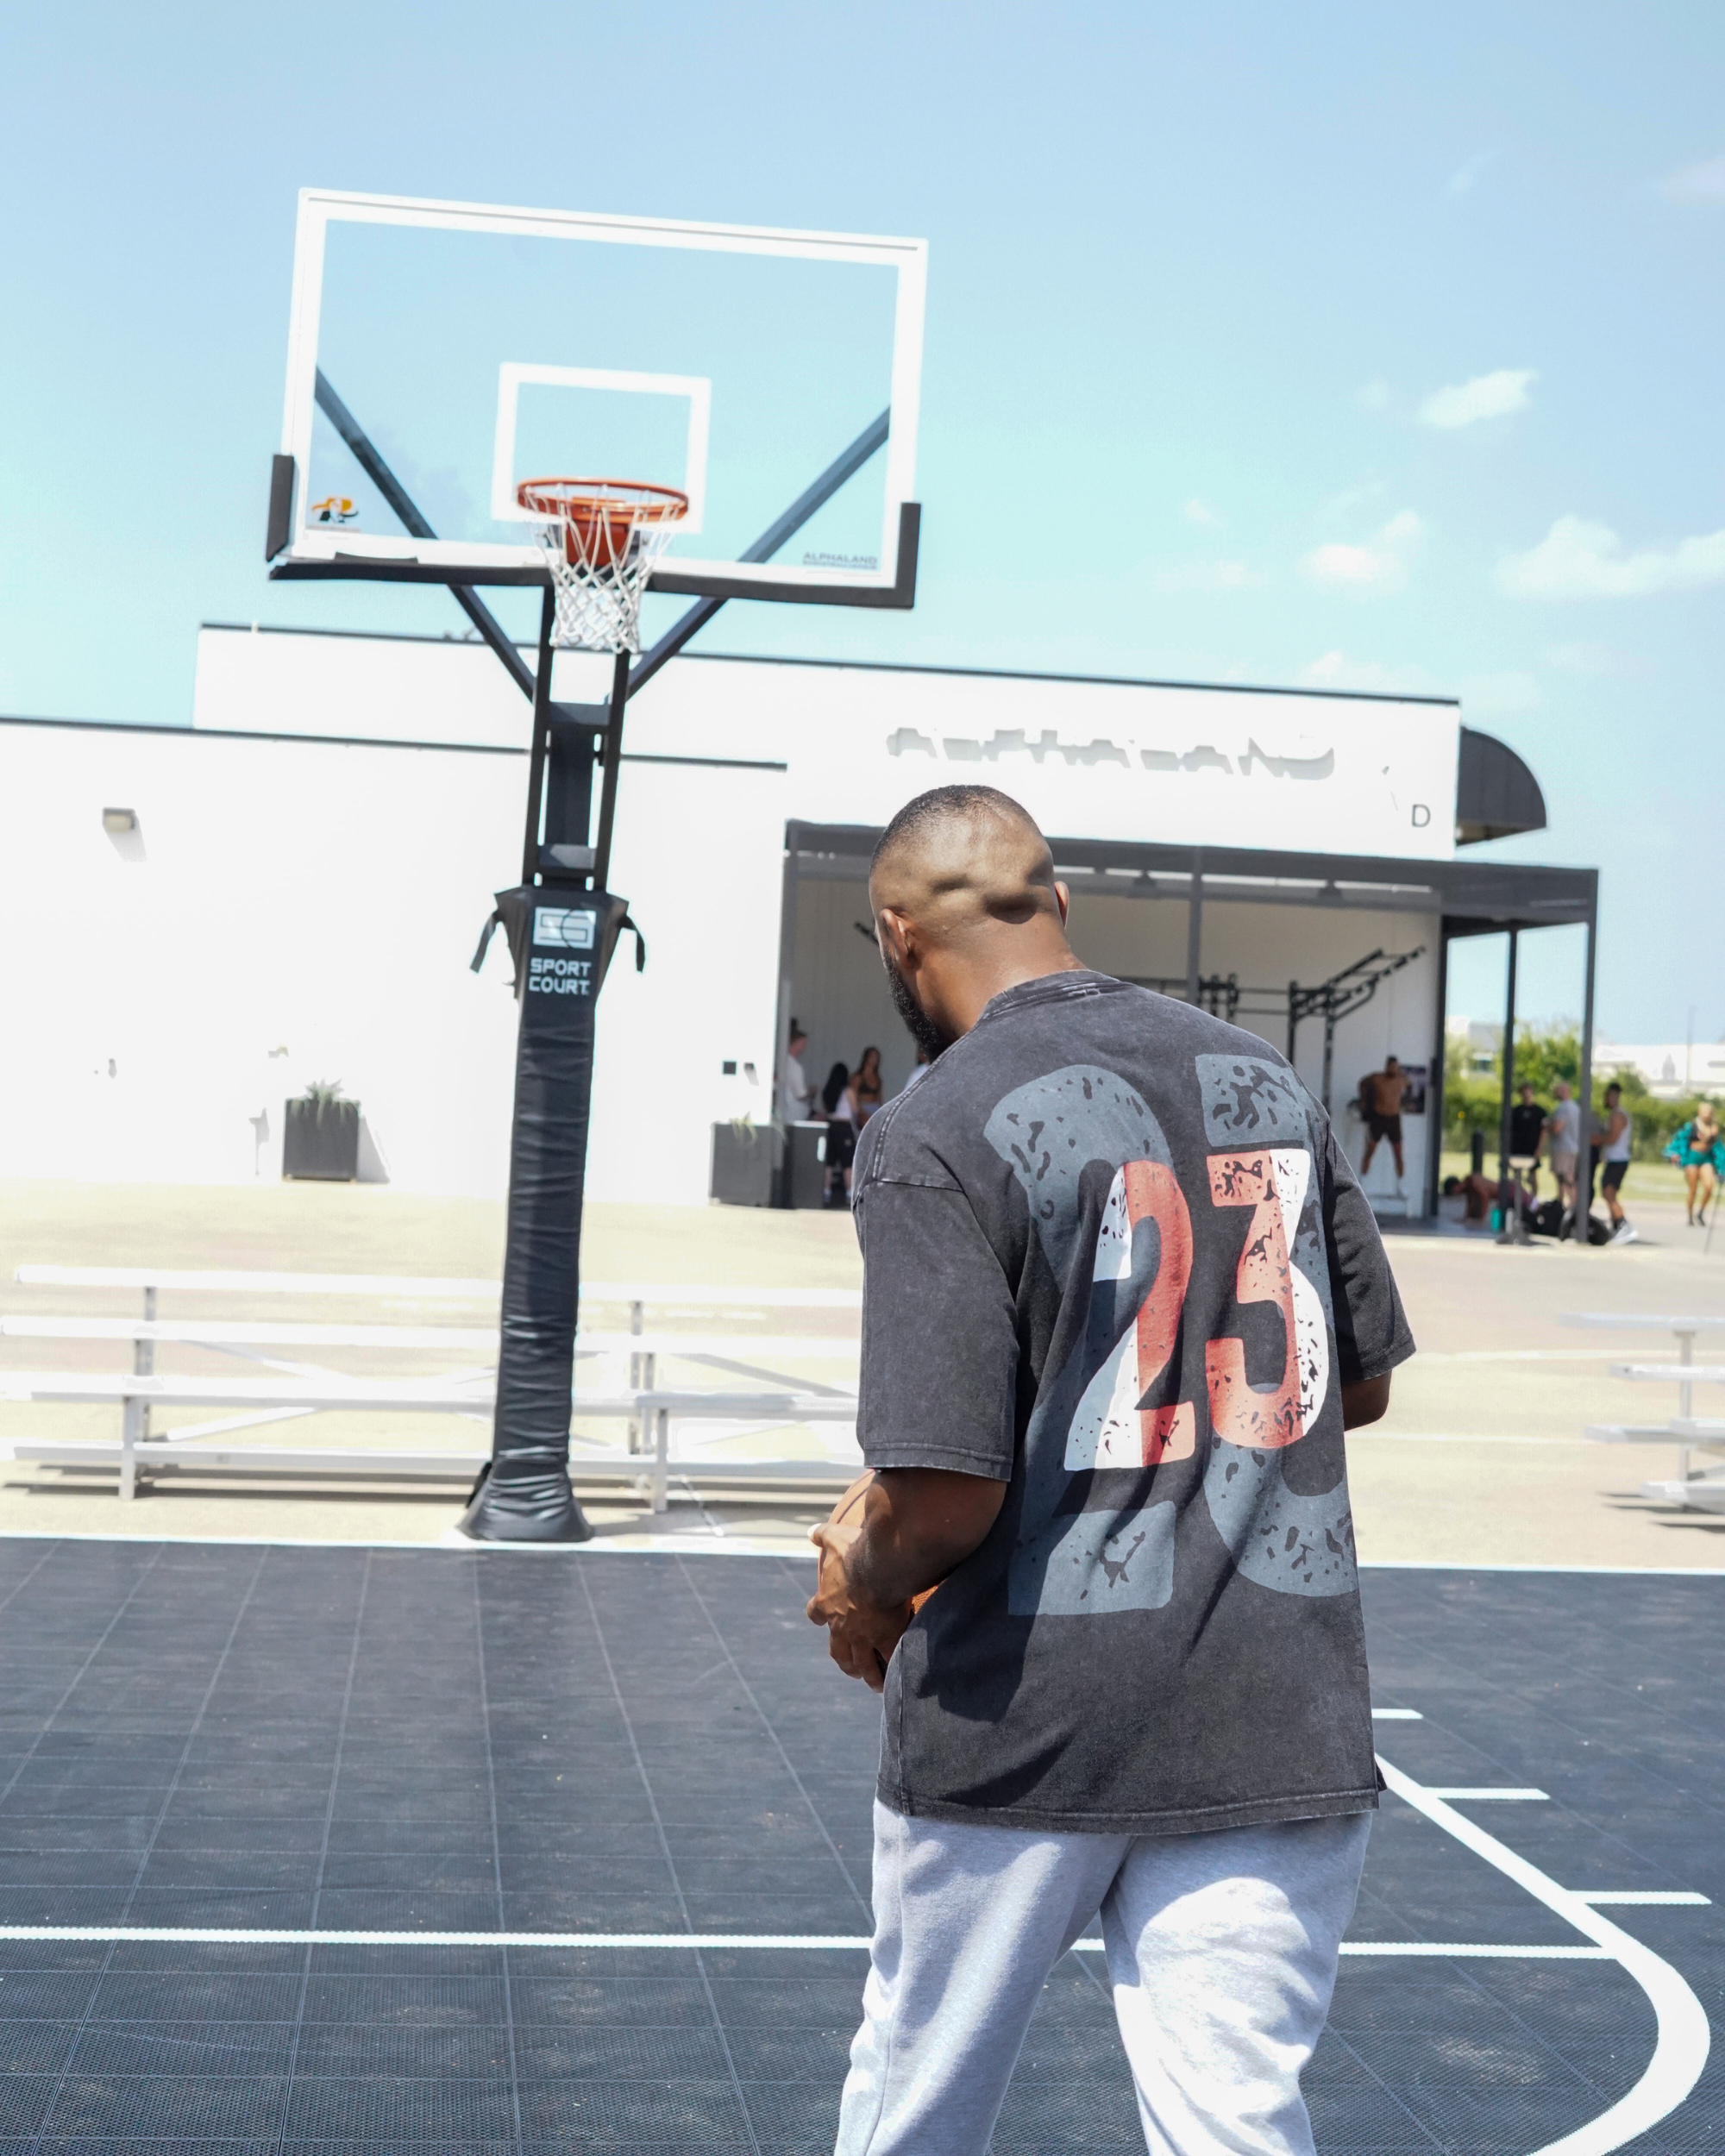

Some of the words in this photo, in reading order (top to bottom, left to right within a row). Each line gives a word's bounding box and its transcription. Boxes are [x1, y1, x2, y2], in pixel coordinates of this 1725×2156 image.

[802, 551, 878, 565] ALPHALAND
[1411, 803, 1431, 828] D
[530, 957, 592, 977] SPORT
[529, 975, 591, 995] COURT
[1063, 1148, 1329, 1471] 23
